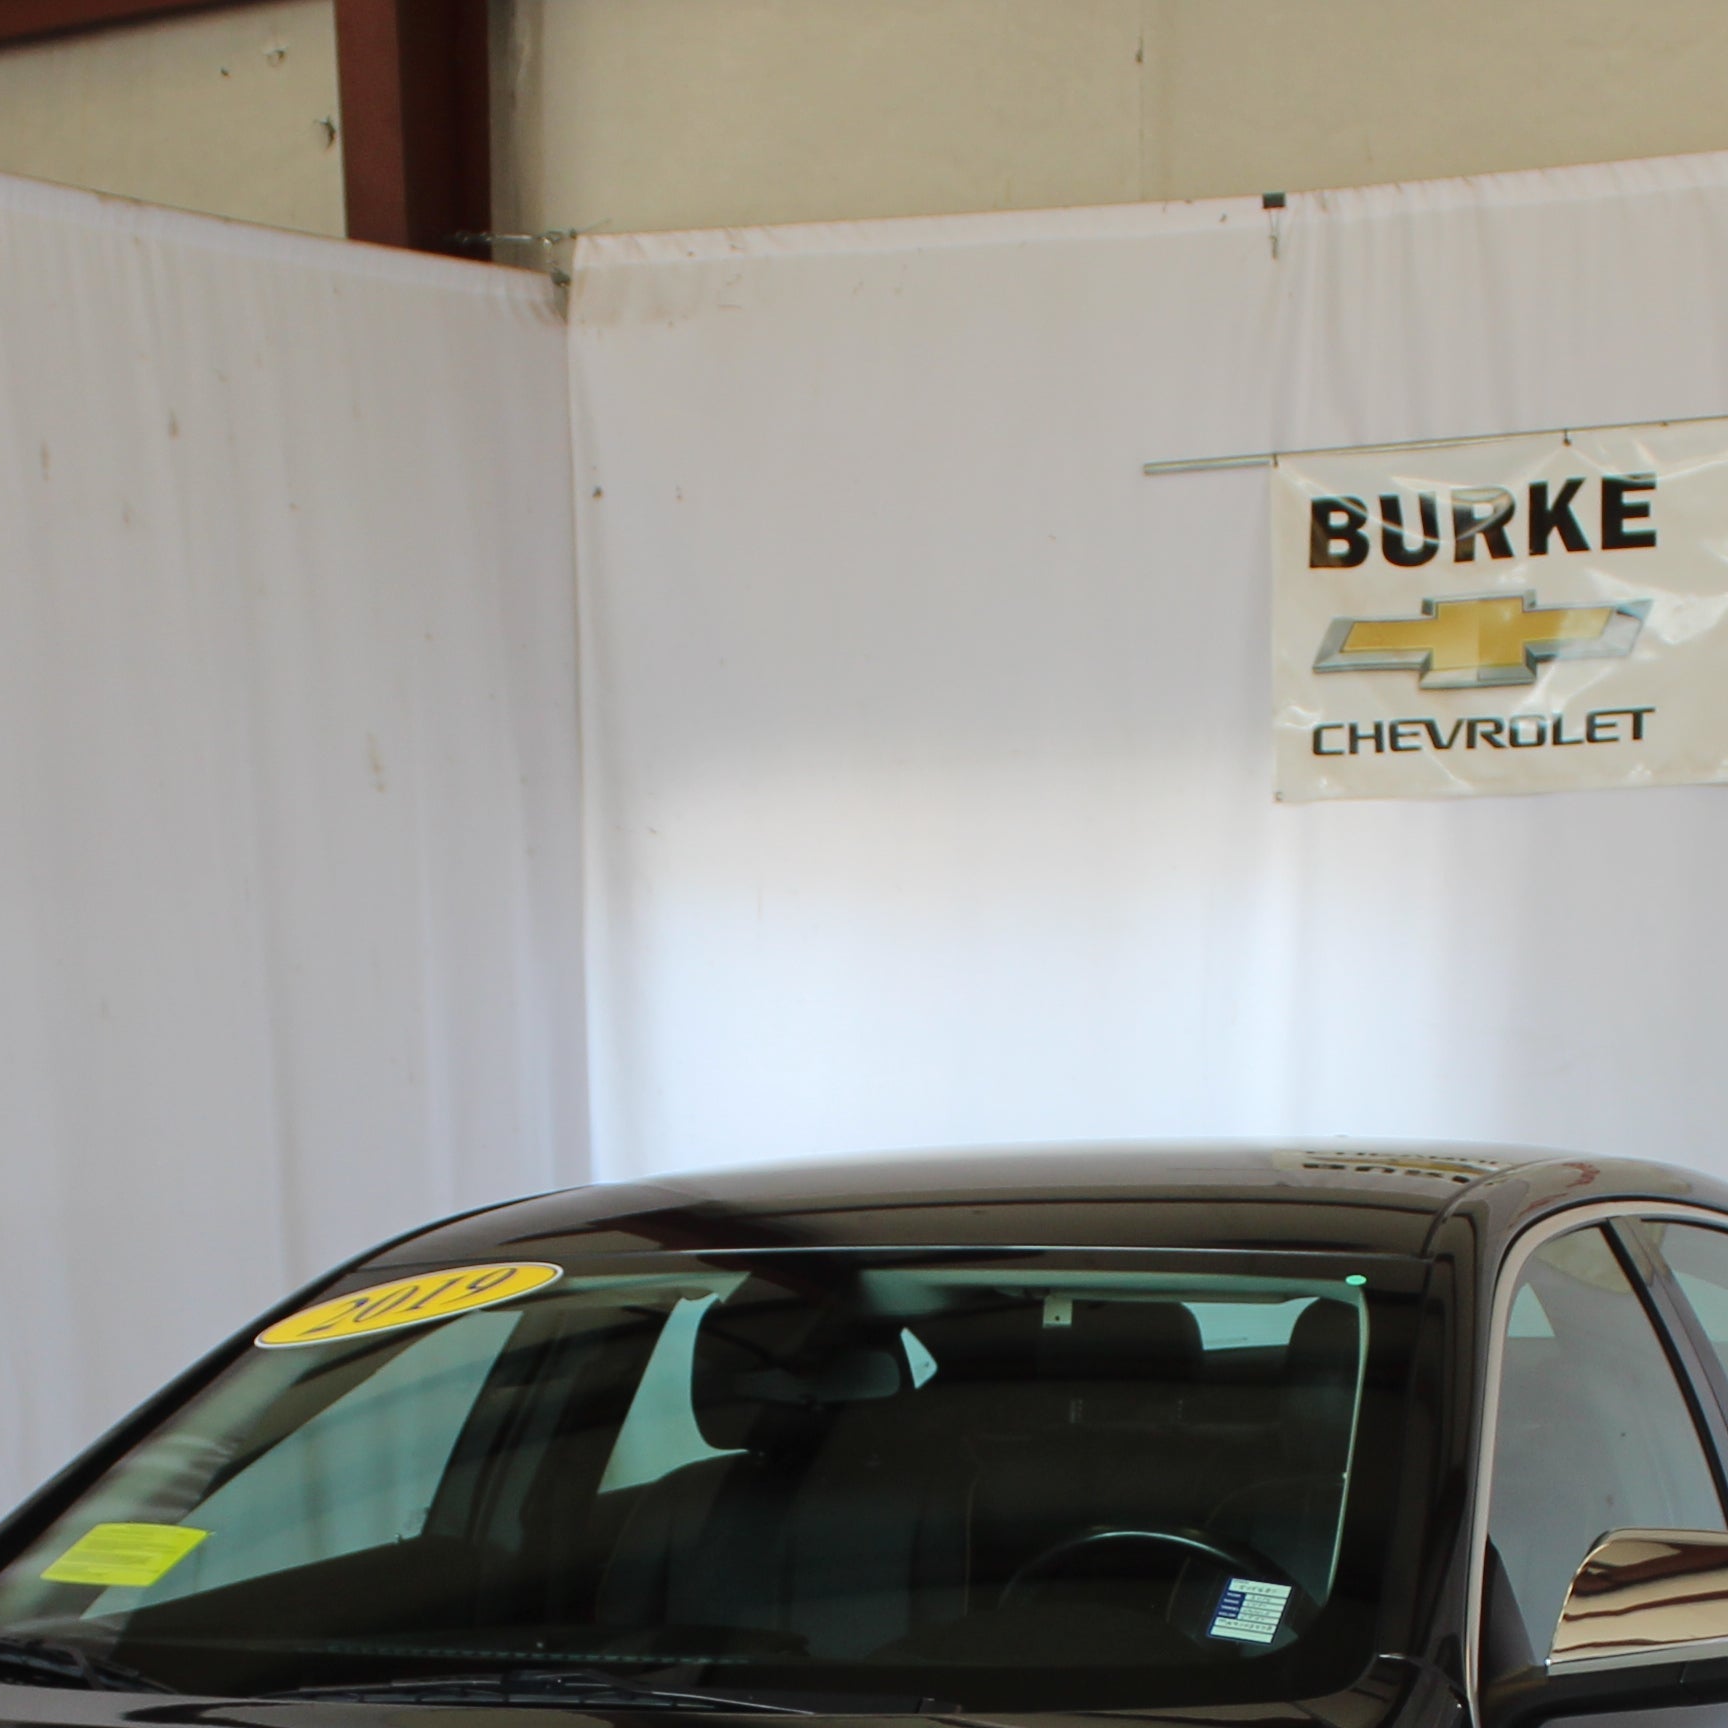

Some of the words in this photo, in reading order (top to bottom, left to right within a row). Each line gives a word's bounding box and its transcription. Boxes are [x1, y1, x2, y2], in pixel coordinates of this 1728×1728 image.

[1309, 472, 1657, 569] BURKE
[1312, 706, 1656, 756] CHEVROLET
[296, 1267, 517, 1337] 2019
